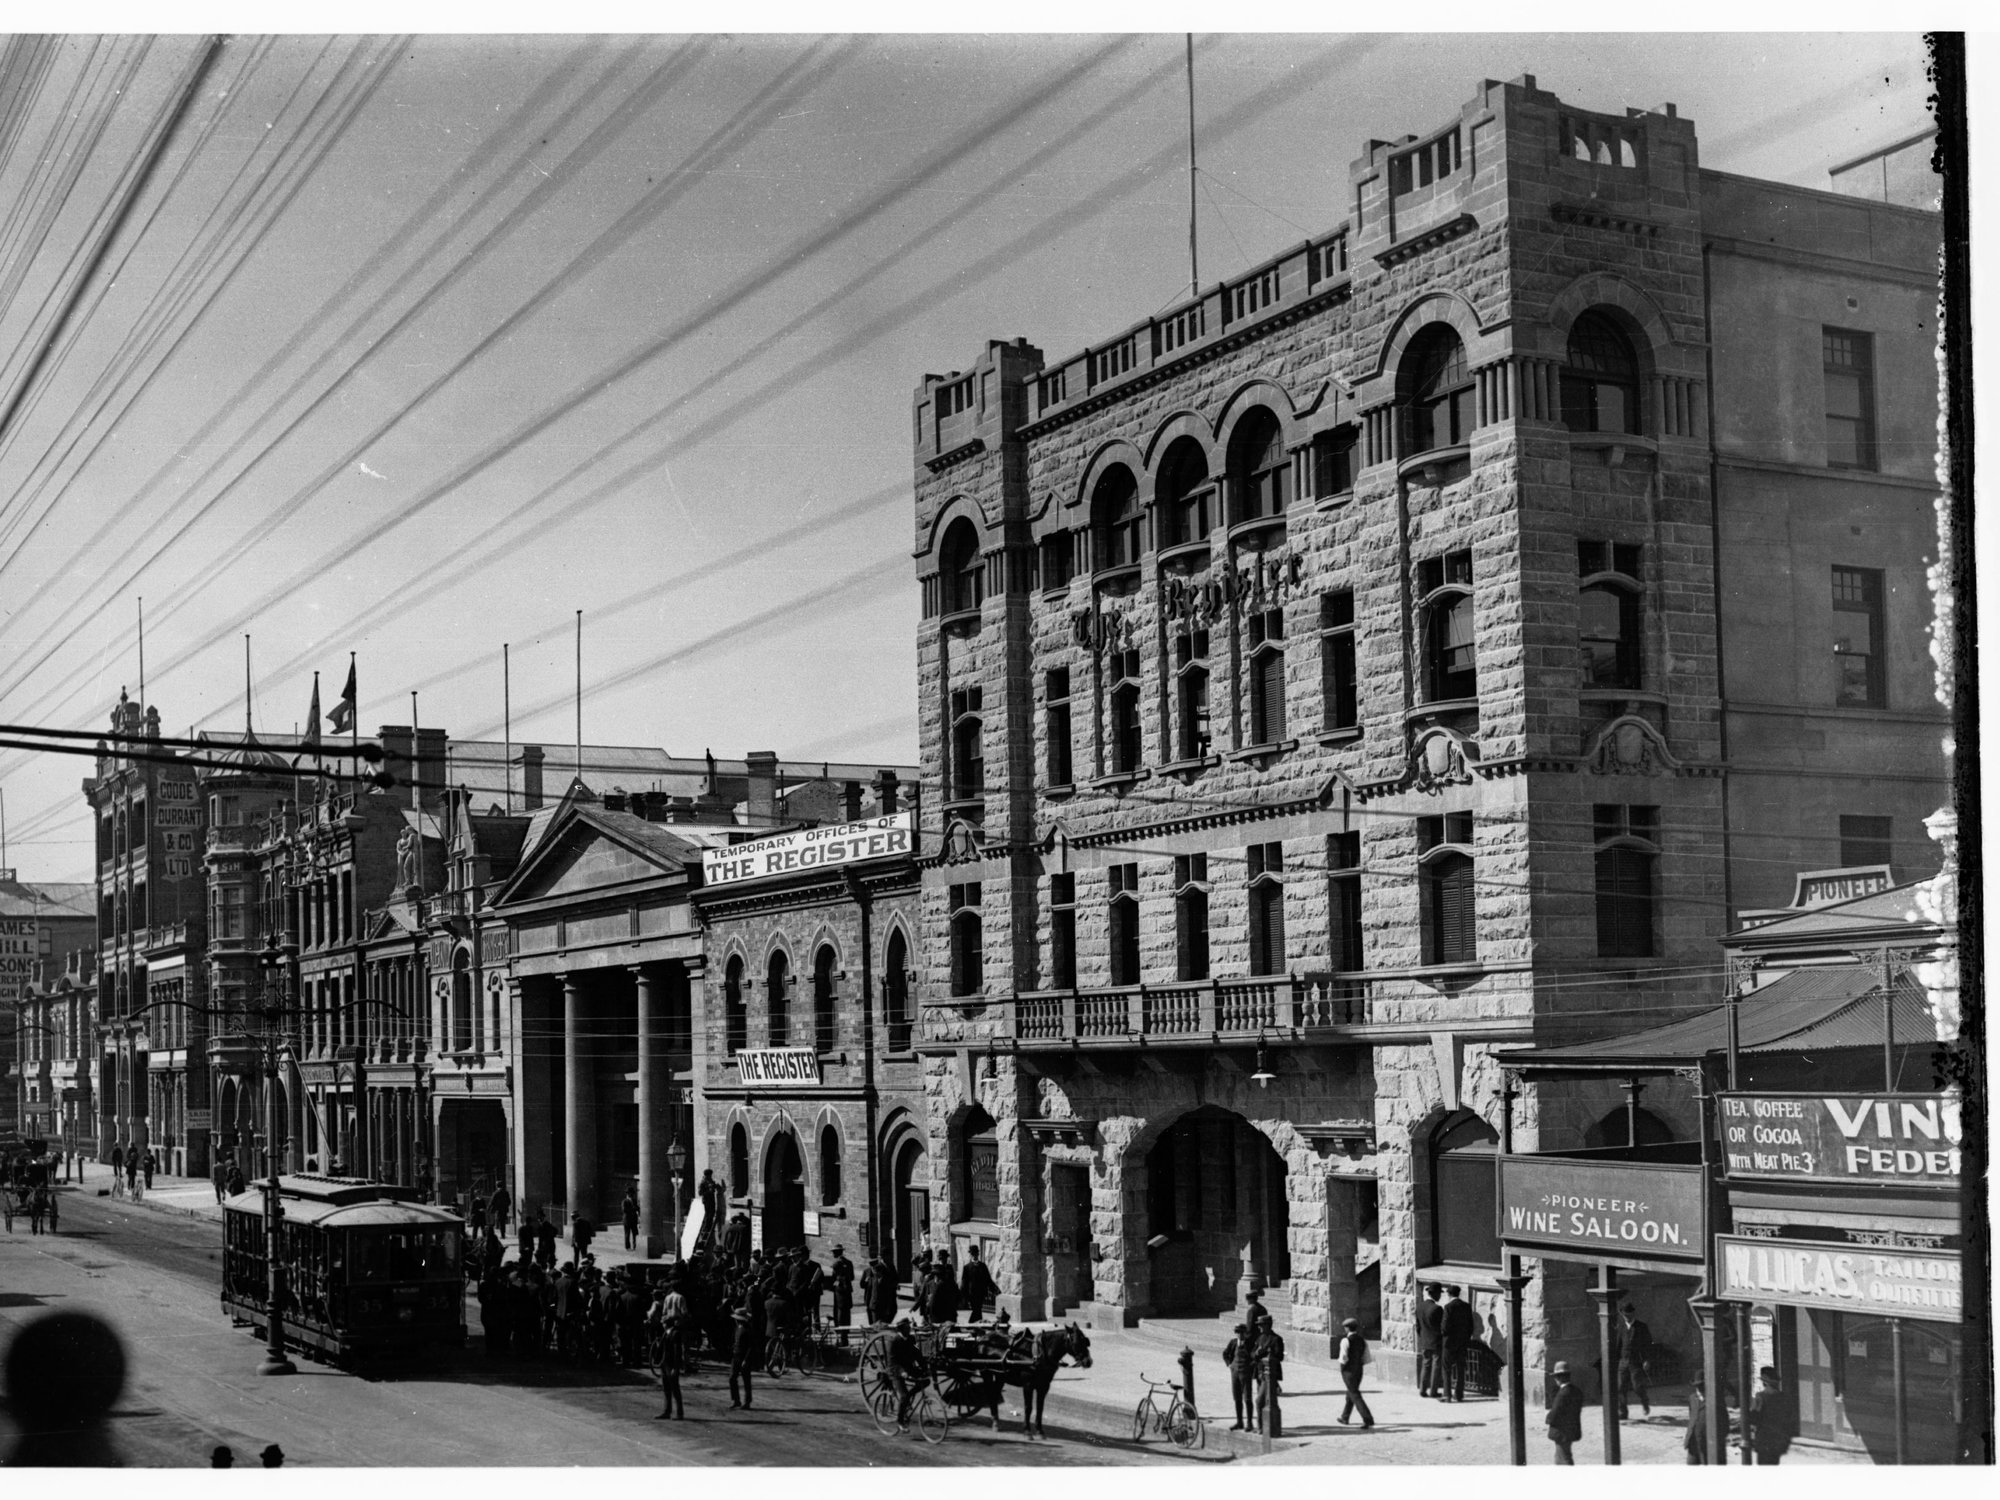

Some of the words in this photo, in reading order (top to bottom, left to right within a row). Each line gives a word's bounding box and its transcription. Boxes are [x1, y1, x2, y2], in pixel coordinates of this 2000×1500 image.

[158, 808, 201, 825] DURRANT
[167, 833, 174, 850] &
[179, 833, 191, 850] CO
[712, 836, 796, 859] TEMPORARY
[806, 822, 868, 842] OFFICES
[878, 816, 897, 829] OF
[707, 858, 755, 882] THE
[766, 829, 907, 873] REGISTER
[169, 859, 189, 875] LTD
[1807, 878, 1888, 901] PIONEER
[738, 1053, 761, 1079] THE
[761, 1052, 818, 1079] REGISTER
[1729, 1127, 1746, 1143] OR
[1728, 1153, 1751, 1169] WITH
[1754, 1152, 1778, 1169] MEAT
[1781, 1153, 1801, 1170] PIE
[1552, 1195, 1636, 1213] PIONEER
[1510, 1206, 1560, 1233] WINE
[1570, 1212, 1688, 1245] SALOON.
